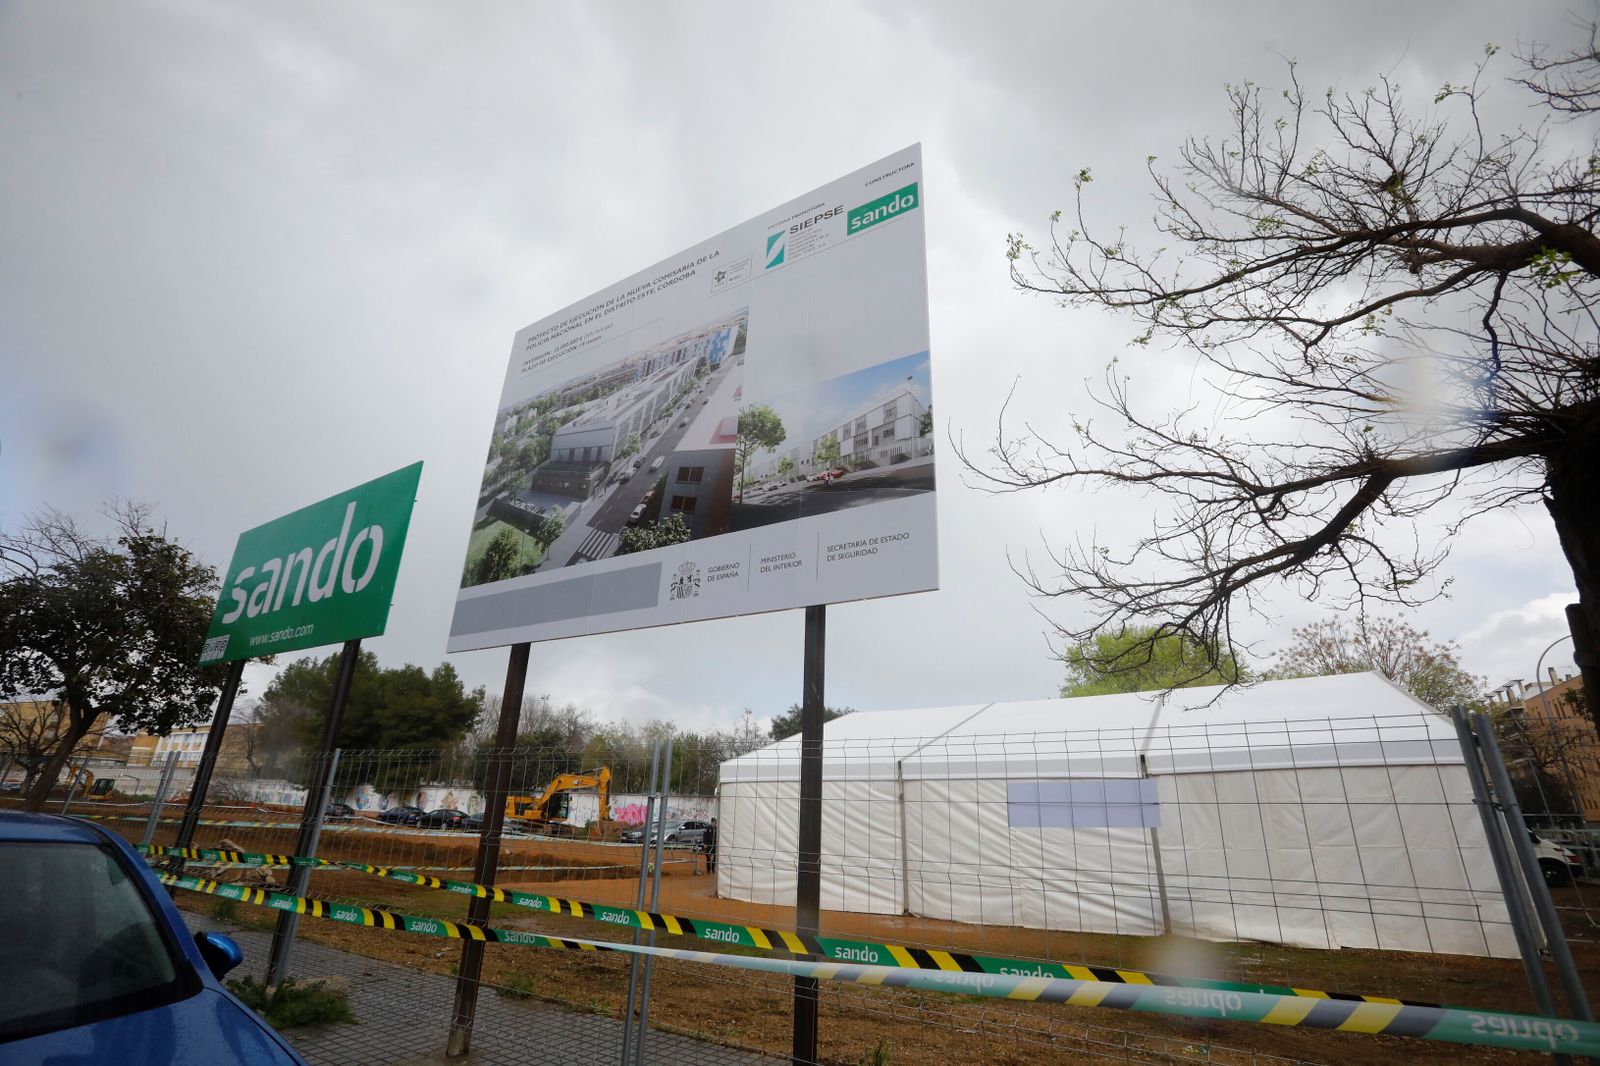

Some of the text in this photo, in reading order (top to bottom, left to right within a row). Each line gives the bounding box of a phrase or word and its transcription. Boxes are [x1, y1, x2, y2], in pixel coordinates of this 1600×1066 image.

[865, 162, 915, 187] CONSTRUCTORA
[789, 204, 844, 235] SIEPSE
[851, 194, 914, 230] sando
[527, 324, 560, 343] PROYECTO
[606, 297, 616, 307] DE
[616, 293, 626, 302] LA
[626, 282, 651, 297] NUEVA
[652, 261, 695, 285] COMISARÍA
[696, 255, 708, 265] DE
[709, 250, 720, 259] LA
[550, 321, 583, 340] NACIONAL
[584, 315, 594, 325] EN
[604, 296, 637, 315] DISTRITO
[826, 532, 910, 553] SECRETARÍA DE ESTADO
[221, 500, 384, 624] sando
[760, 552, 796, 565] MINISTERIO
[826, 547, 878, 562] DE SEGURIDAD
[708, 562, 740, 573] GOBIERNO
[760, 560, 803, 573] DEL INTERIOR
[707, 574, 715, 582] DE
[249, 623, 314, 646] www.sando.com
[516, 895, 543, 909] sando
[333, 908, 357, 922] sando
[600, 909, 630, 925] sando
[410, 920, 438, 934] sando
[704, 926, 740, 943] sando
[504, 930, 536, 945] sando
[834, 944, 879, 963] sando
